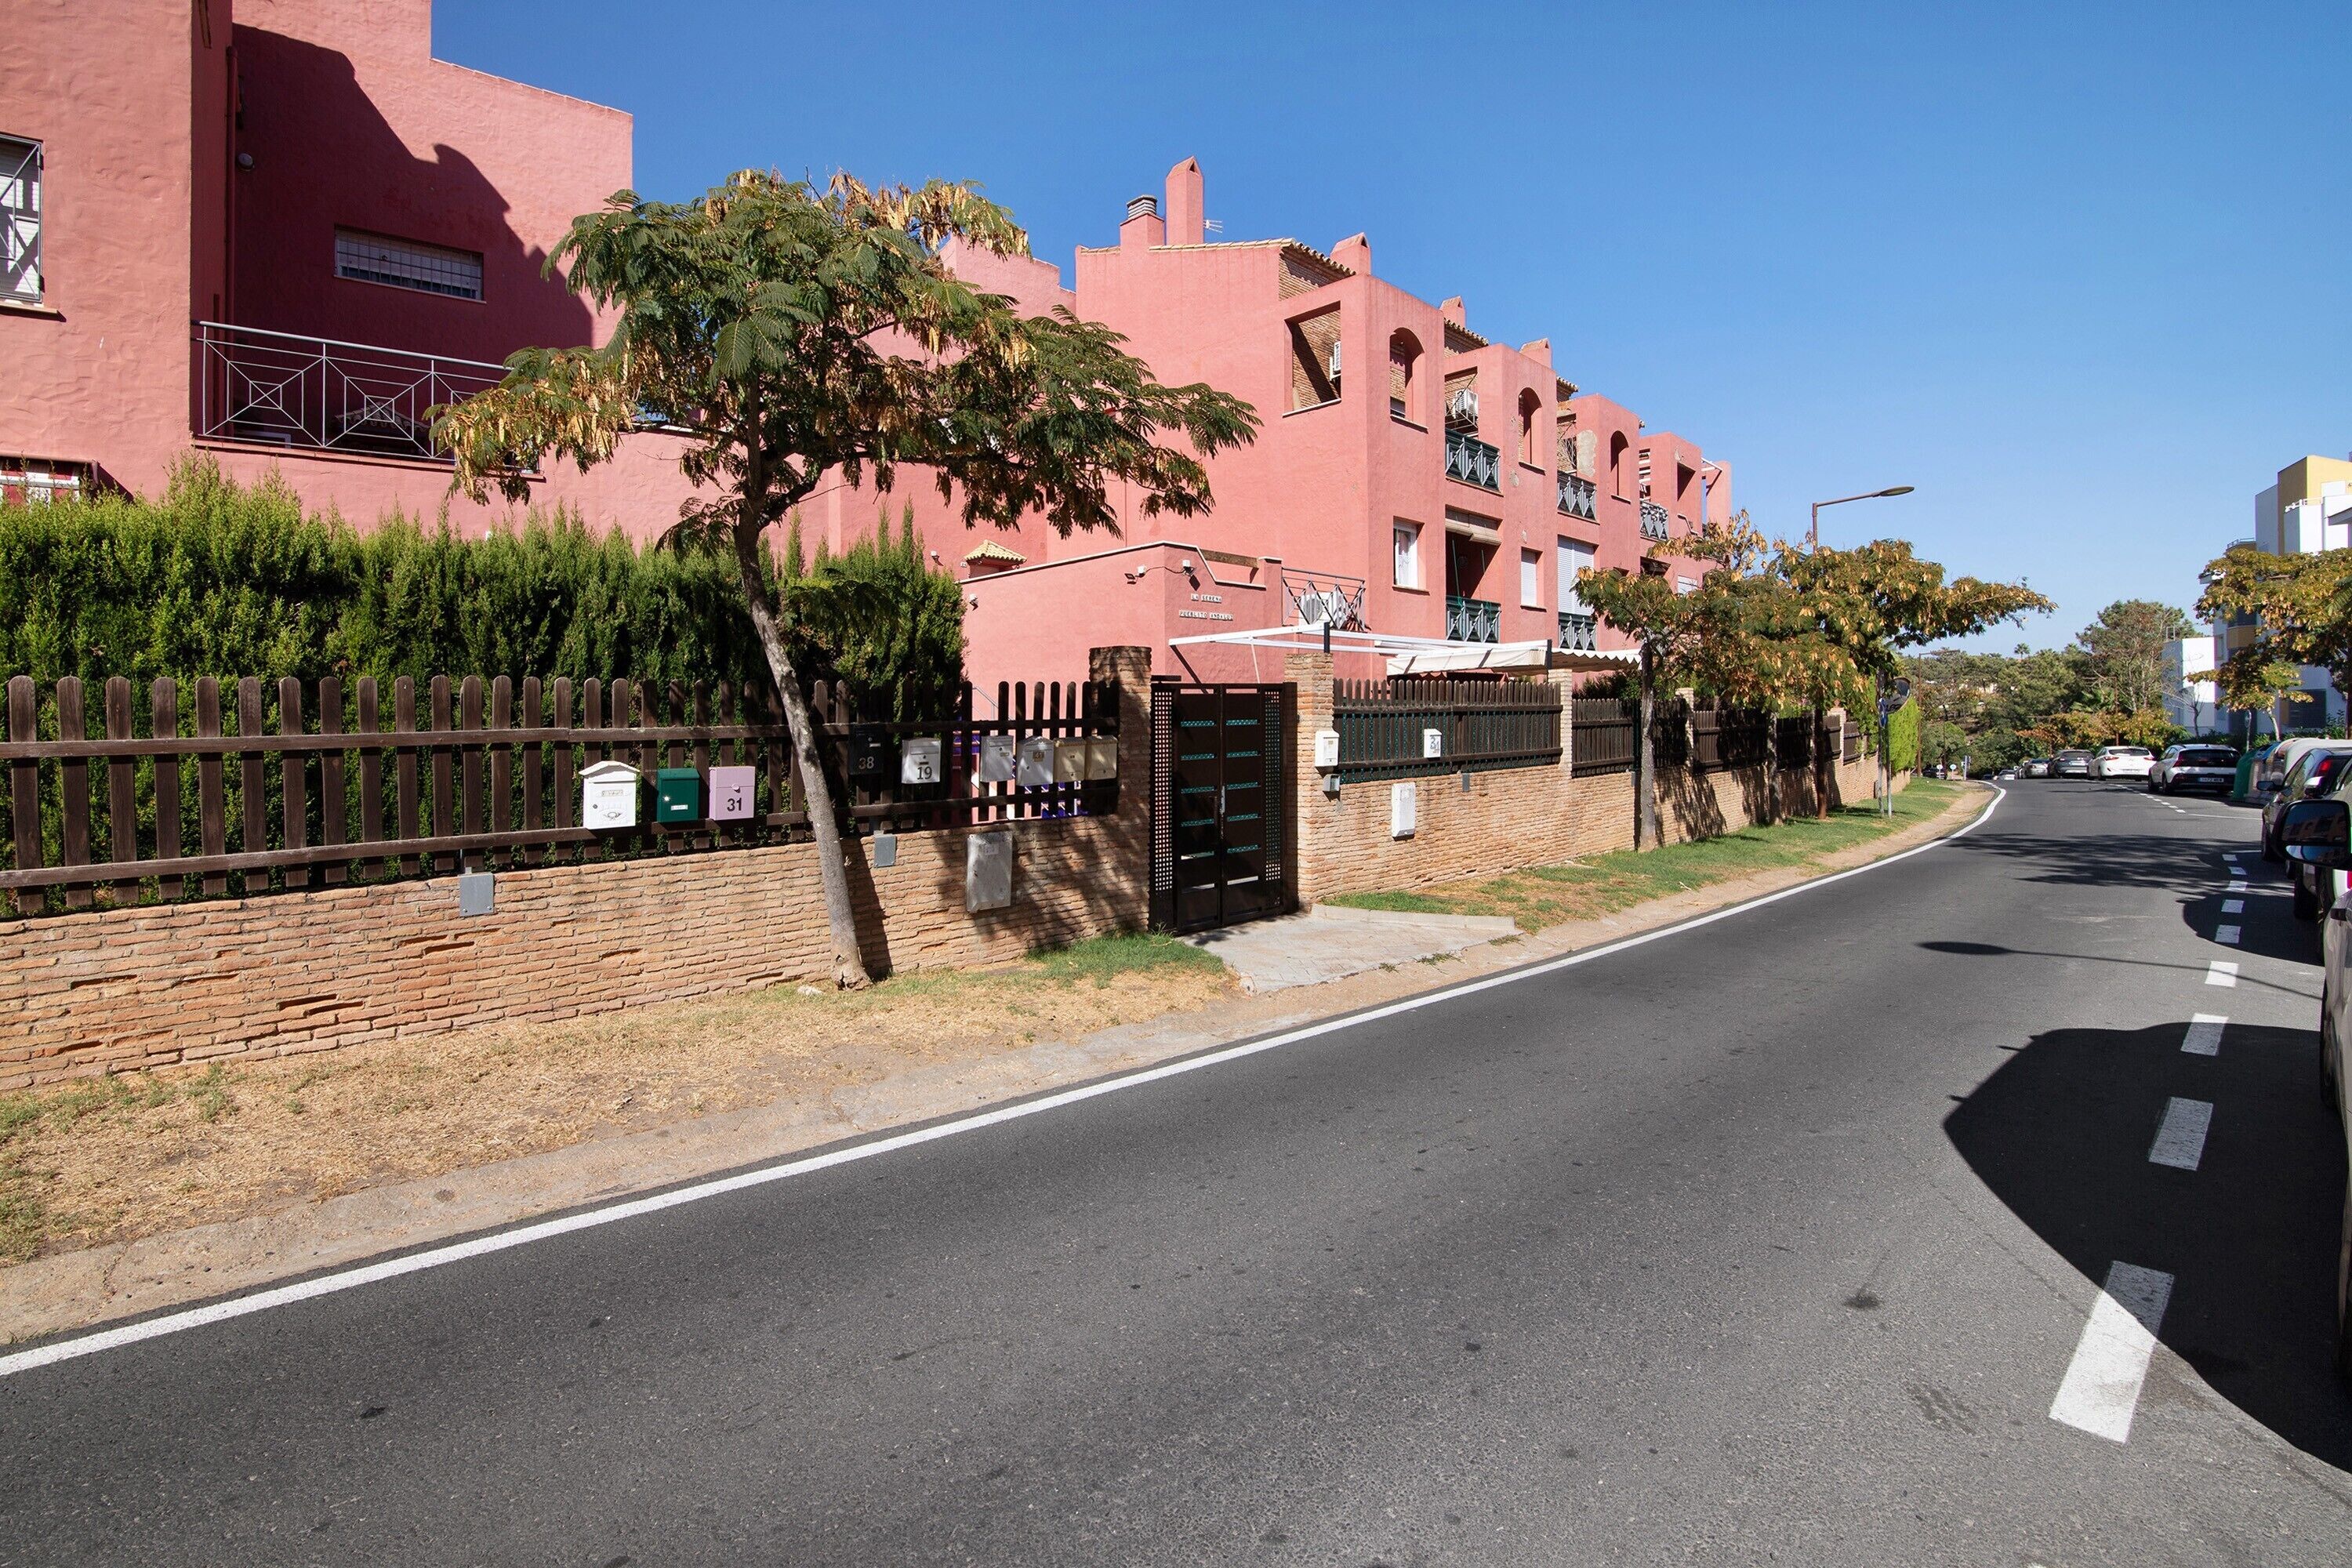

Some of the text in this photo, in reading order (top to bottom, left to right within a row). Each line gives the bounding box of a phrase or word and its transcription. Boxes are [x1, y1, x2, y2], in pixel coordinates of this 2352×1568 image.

[858, 757, 874, 769] 38
[916, 767, 932, 780] 19
[727, 797, 742, 811] 31
